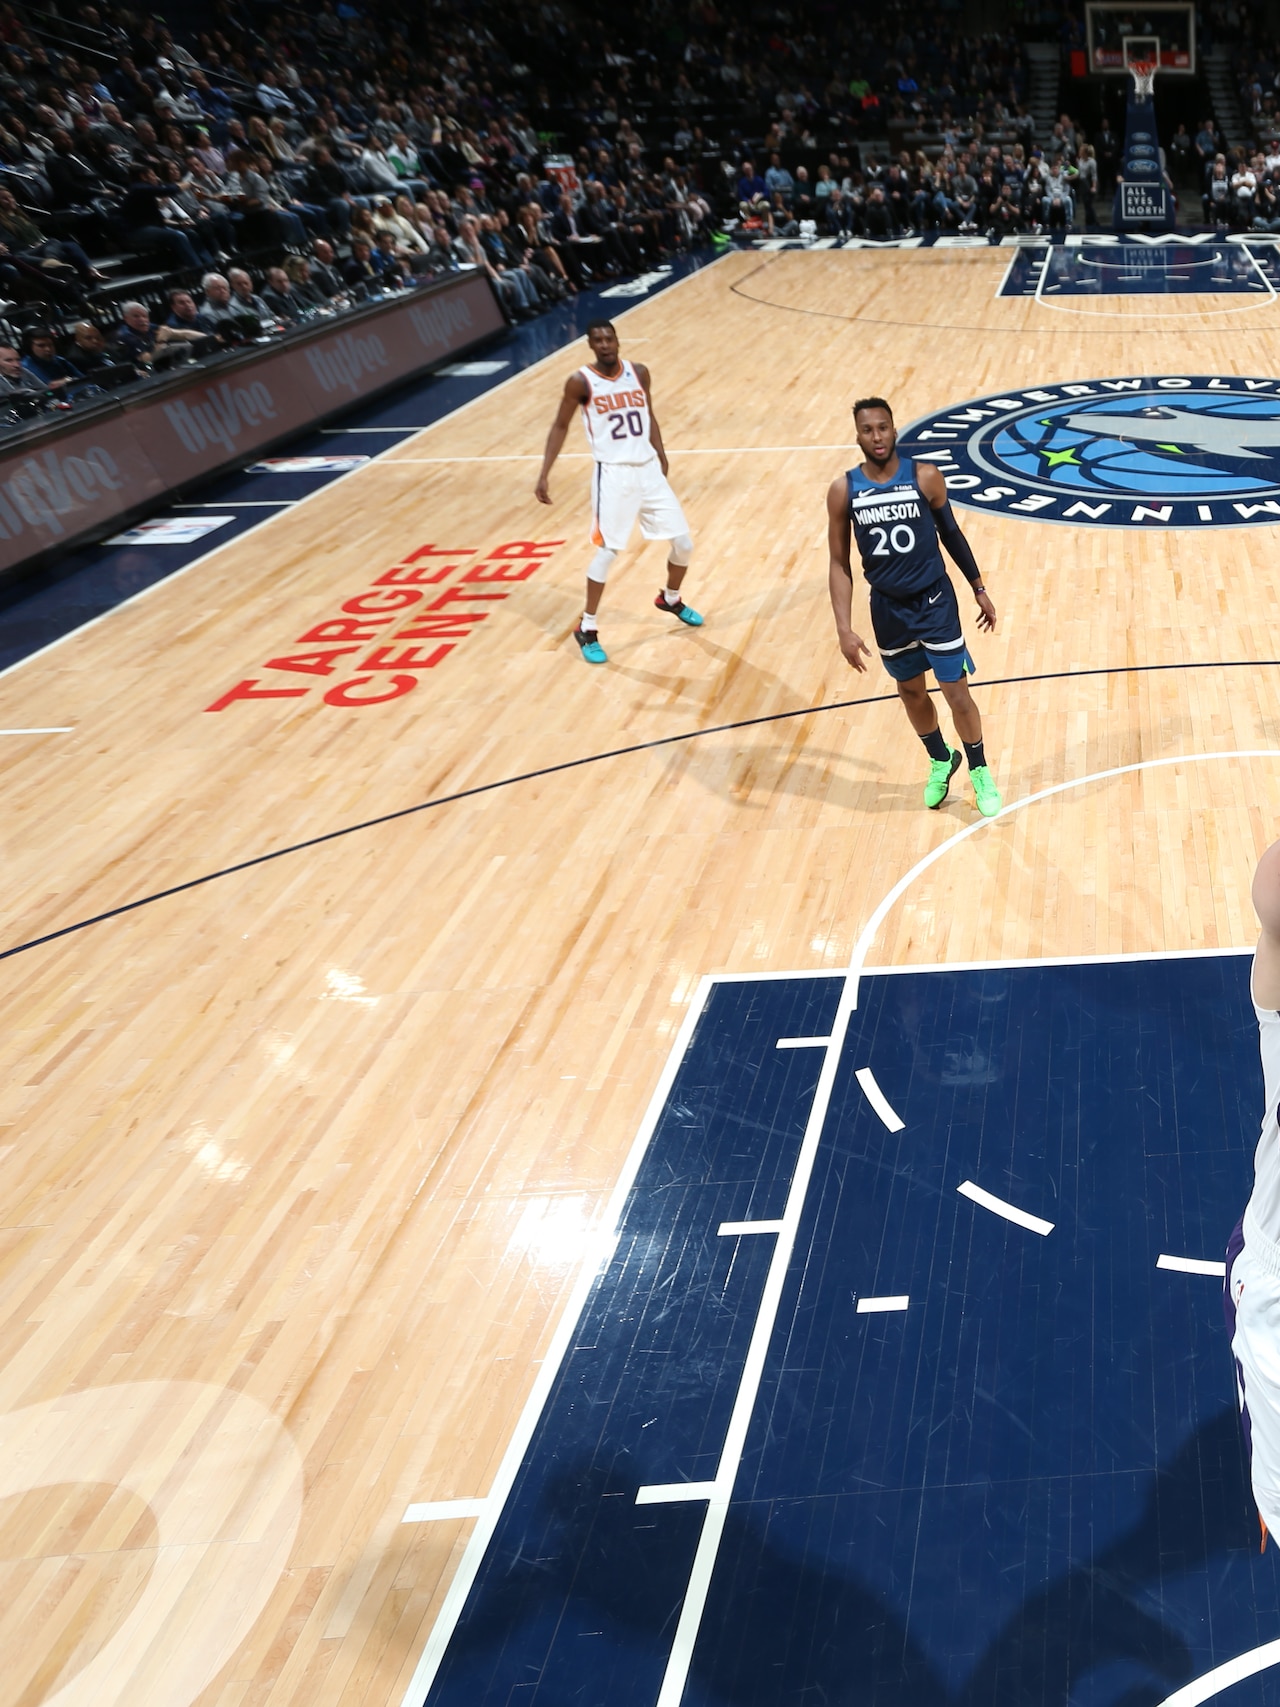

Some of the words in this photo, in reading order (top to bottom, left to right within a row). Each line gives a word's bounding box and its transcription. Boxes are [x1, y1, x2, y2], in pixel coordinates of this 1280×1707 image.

[1127, 187, 1146, 196] ALL
[1127, 197, 1153, 205] EYES
[1127, 206, 1165, 215] NORTH
[593, 390, 646, 415] SUNS
[162, 379, 277, 455] HyVee
[608, 410, 643, 440] 20
[854, 502, 921, 525] MINNESOTA
[868, 524, 916, 556] 20
[203, 543, 480, 712] TARGET
[323, 540, 566, 707] CENTER
